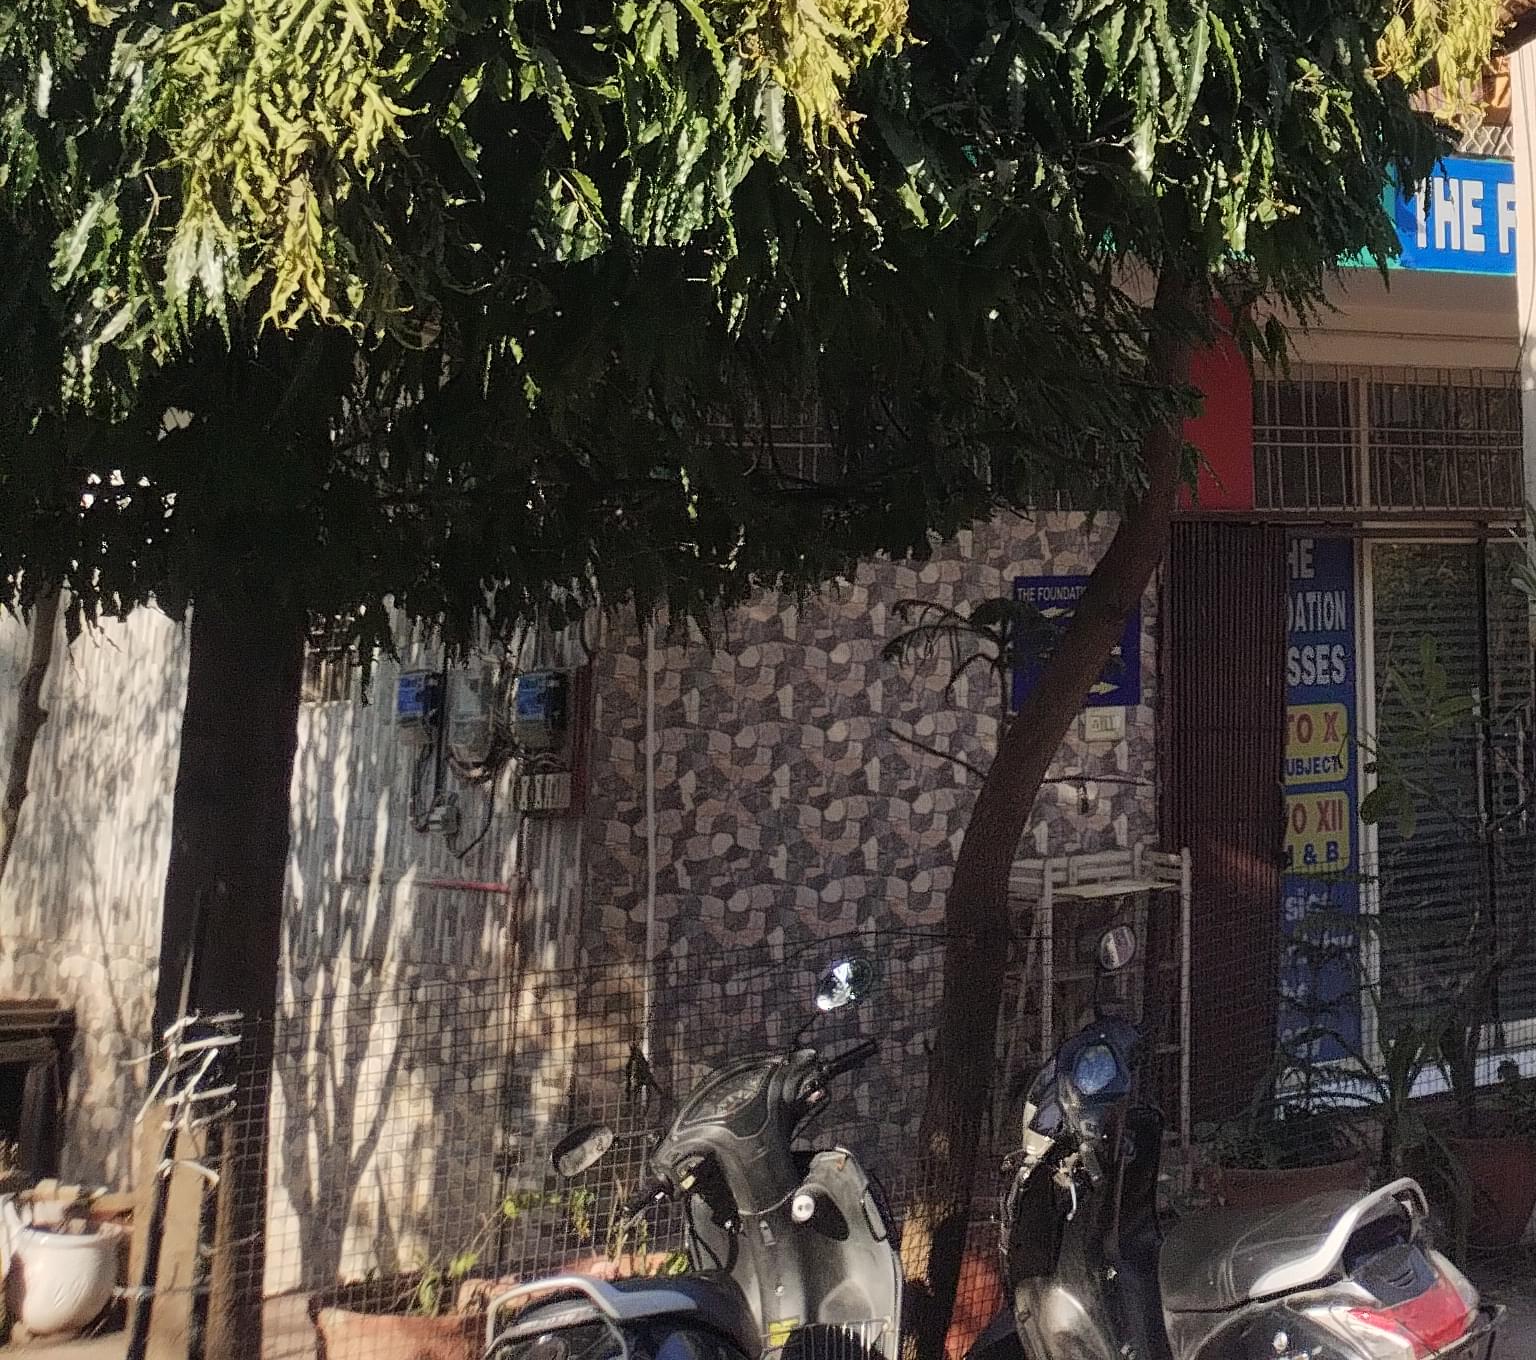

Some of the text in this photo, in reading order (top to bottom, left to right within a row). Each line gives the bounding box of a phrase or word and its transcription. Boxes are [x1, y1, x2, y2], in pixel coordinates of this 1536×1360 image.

[1414, 176, 1486, 252] THE
[1017, 585, 1087, 602] THE FOUNDAT
[1323, 711, 1339, 743] X
